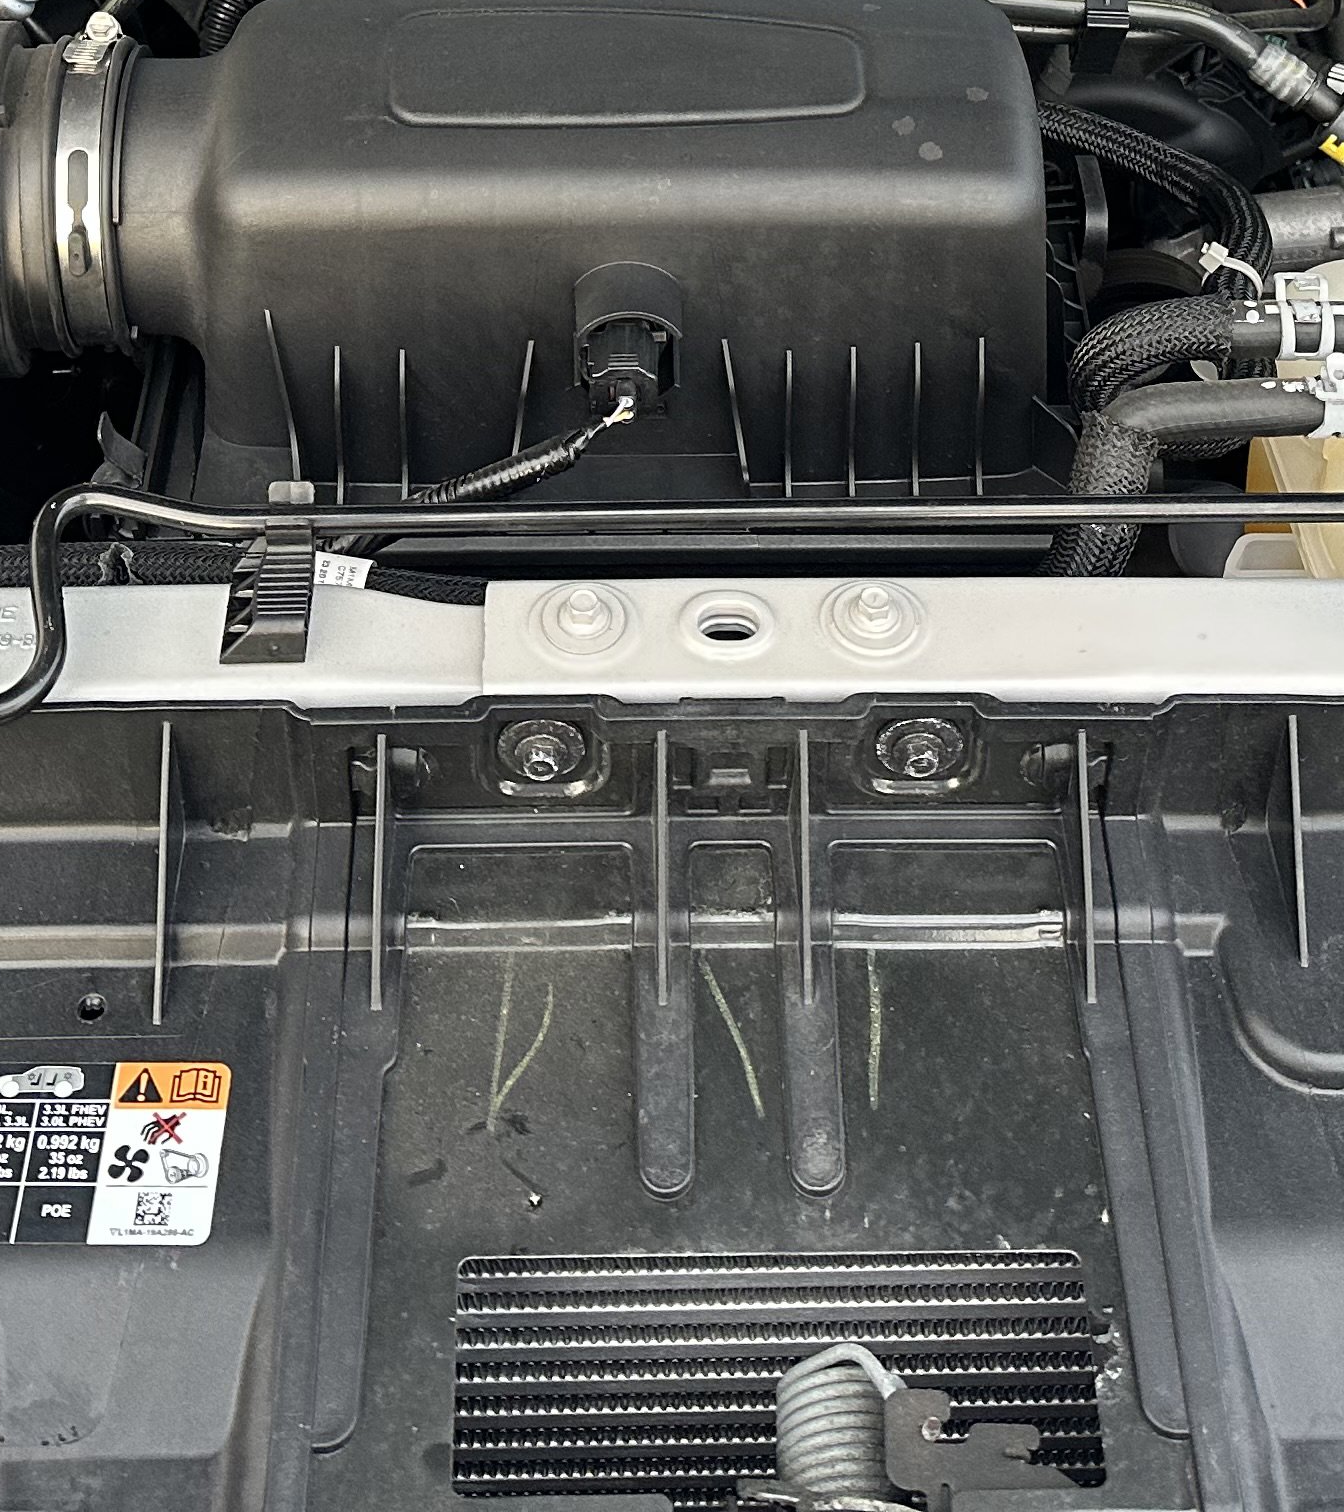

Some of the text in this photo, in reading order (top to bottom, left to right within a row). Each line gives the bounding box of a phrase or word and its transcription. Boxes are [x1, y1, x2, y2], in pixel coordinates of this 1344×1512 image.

[42, 1104, 107, 1115] 3.3L FHEV
[2, 1116, 29, 1126] 3.3L
[40, 1116, 105, 1126] 3.0L PHEV
[5, 1134, 26, 1152] kg
[37, 1134, 100, 1153] 0.992 kg
[48, 1152, 84, 1165] 35 oz
[38, 1166, 89, 1179] 2.19 lbs
[41, 1204, 72, 1218] POE
